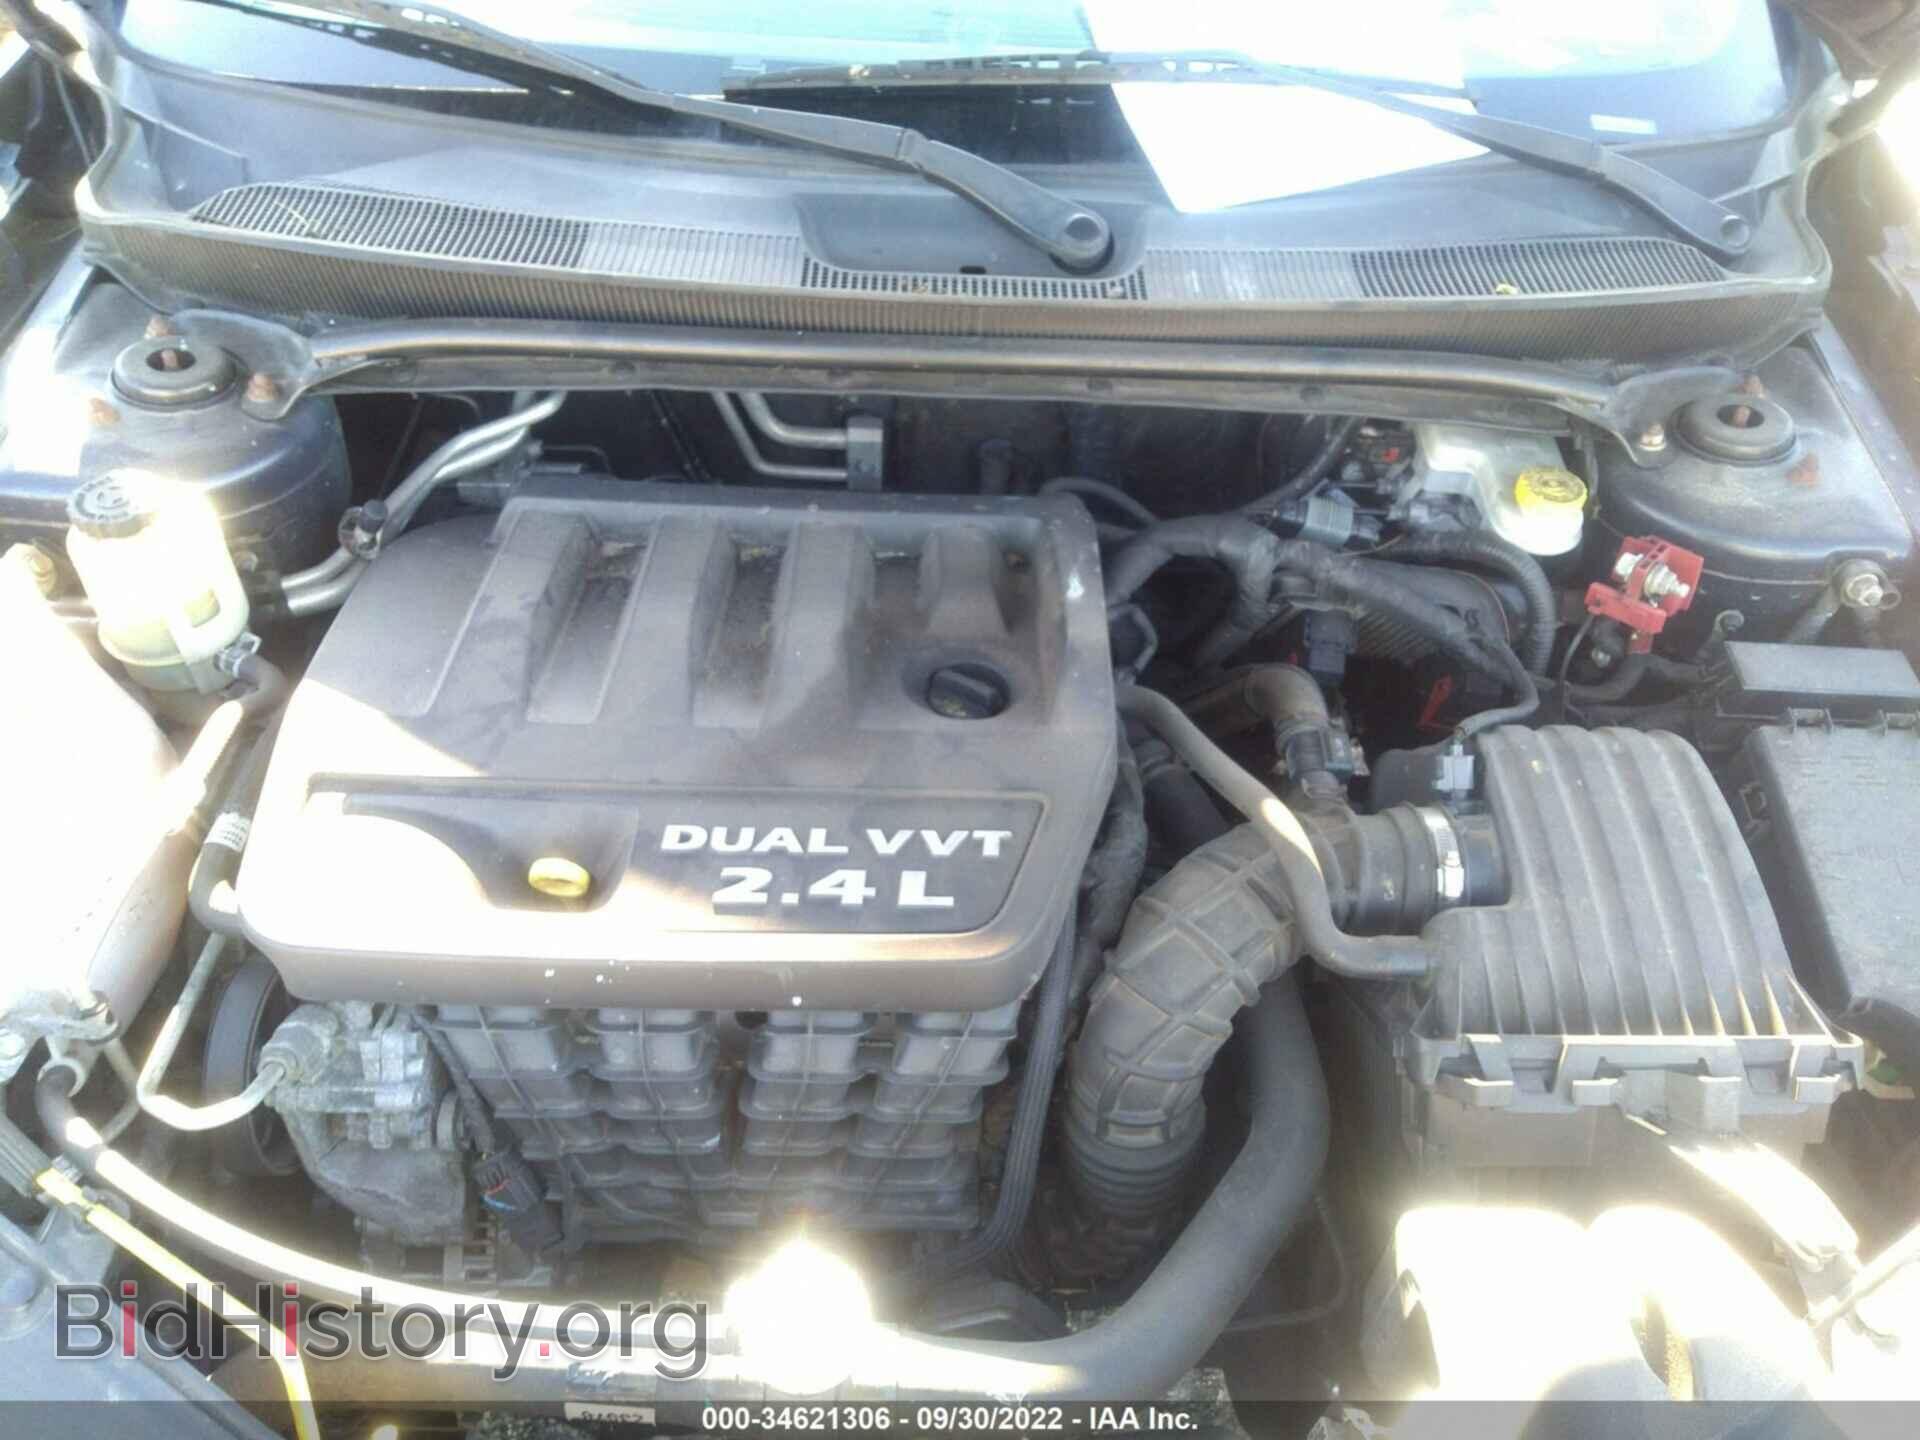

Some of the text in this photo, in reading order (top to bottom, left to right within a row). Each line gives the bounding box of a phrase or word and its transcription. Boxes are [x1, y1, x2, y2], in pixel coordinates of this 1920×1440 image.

[660, 824, 1013, 857] DUAL VVT
[712, 866, 955, 908] 2.4 L
